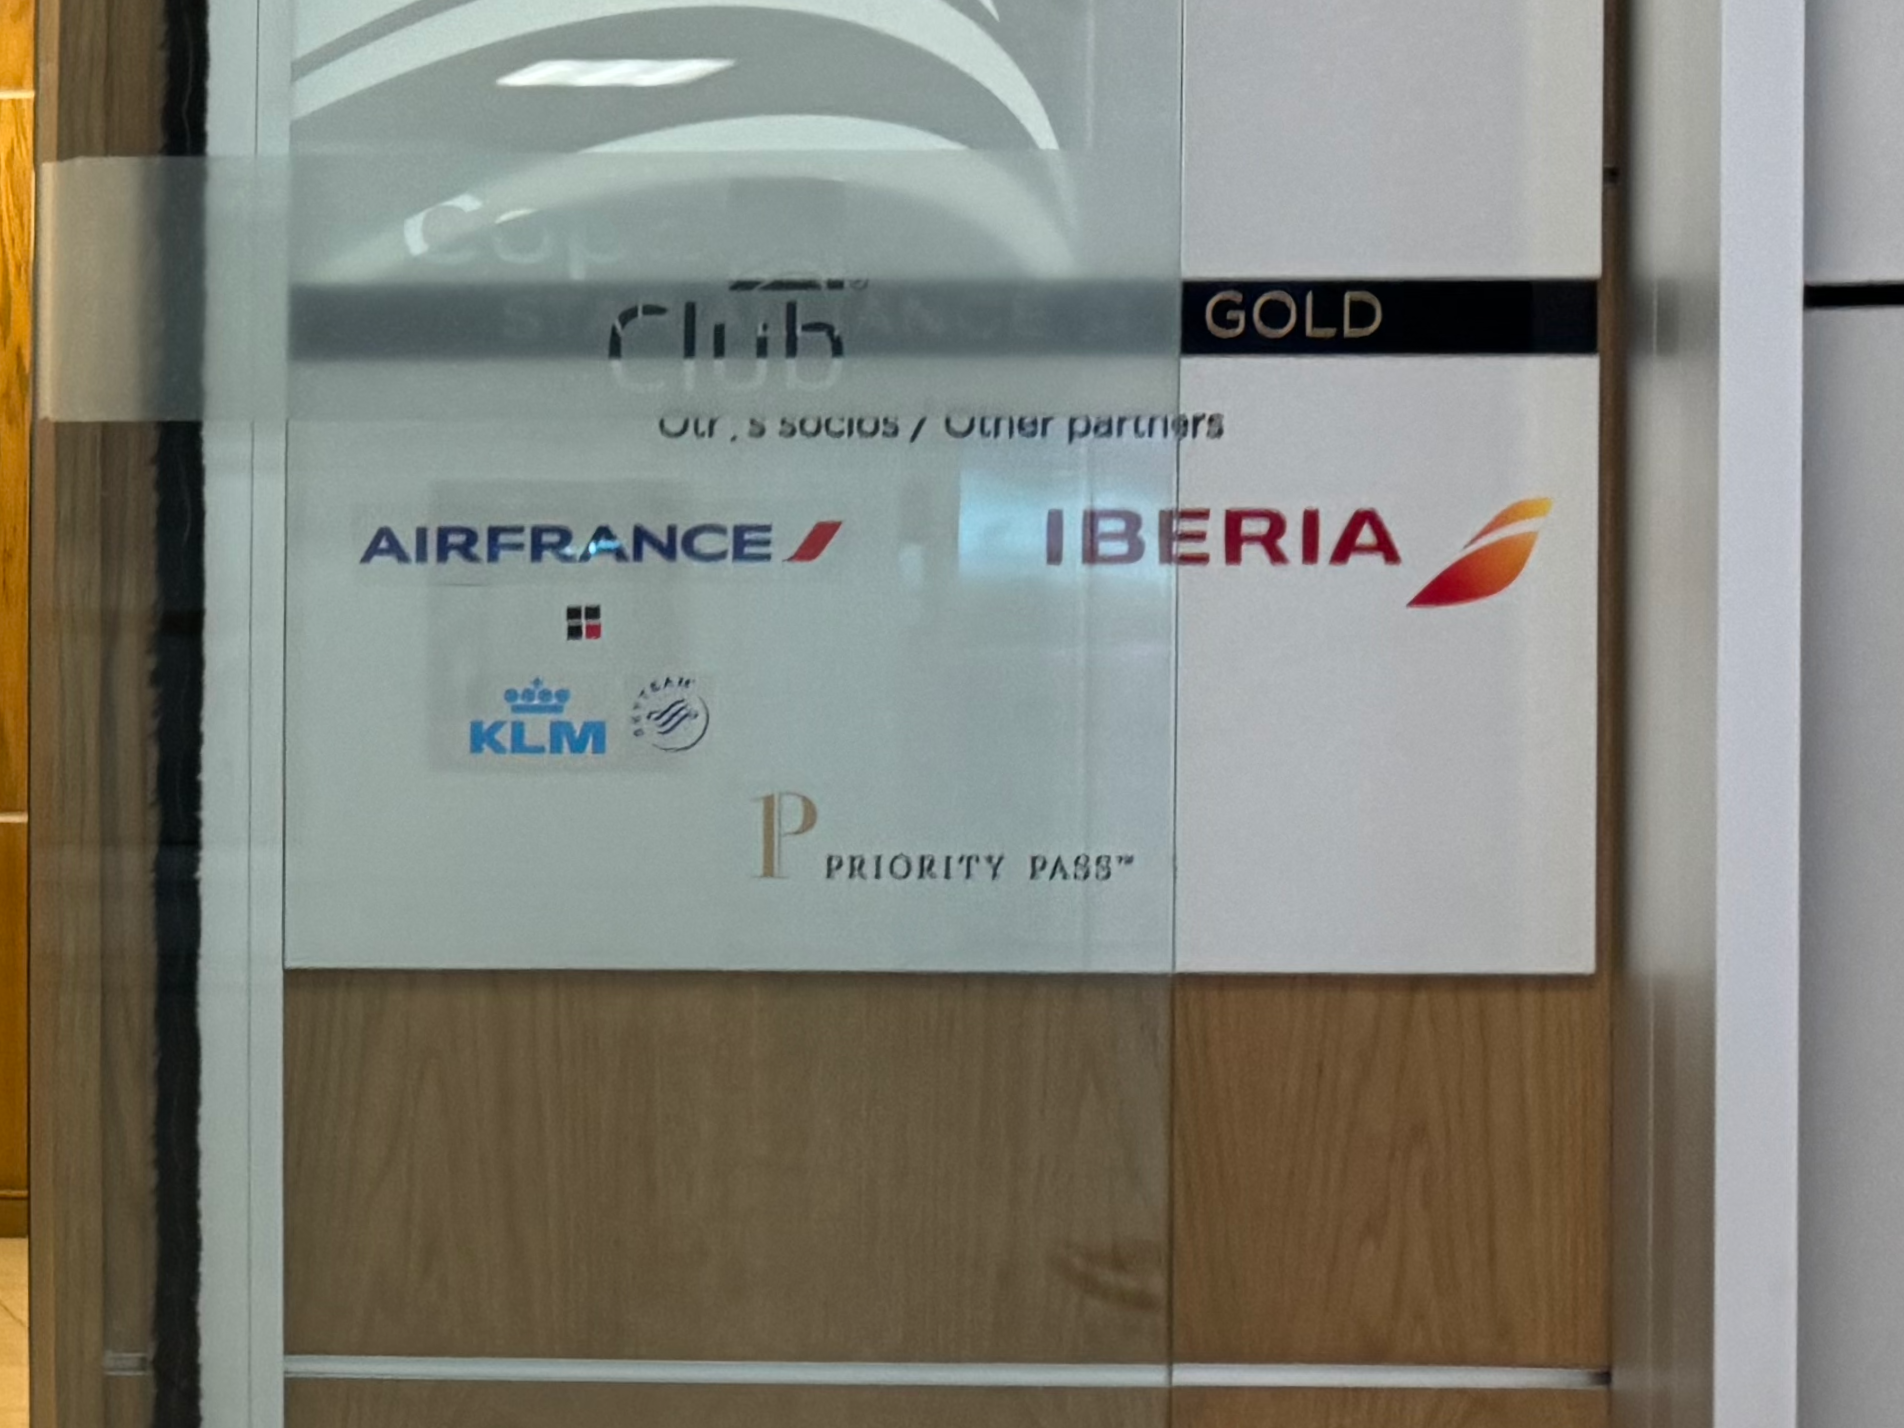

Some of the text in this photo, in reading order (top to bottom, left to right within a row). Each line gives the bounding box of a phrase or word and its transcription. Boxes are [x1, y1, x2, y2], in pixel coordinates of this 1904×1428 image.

[1205, 289, 1382, 339] GOLD
[608, 300, 846, 394] Club
[359, 523, 773, 564] AIRFRANCE
[1045, 507, 1402, 566] IBERIA
[469, 719, 607, 755] KLM
[824, 851, 1006, 882] PRIORITY
